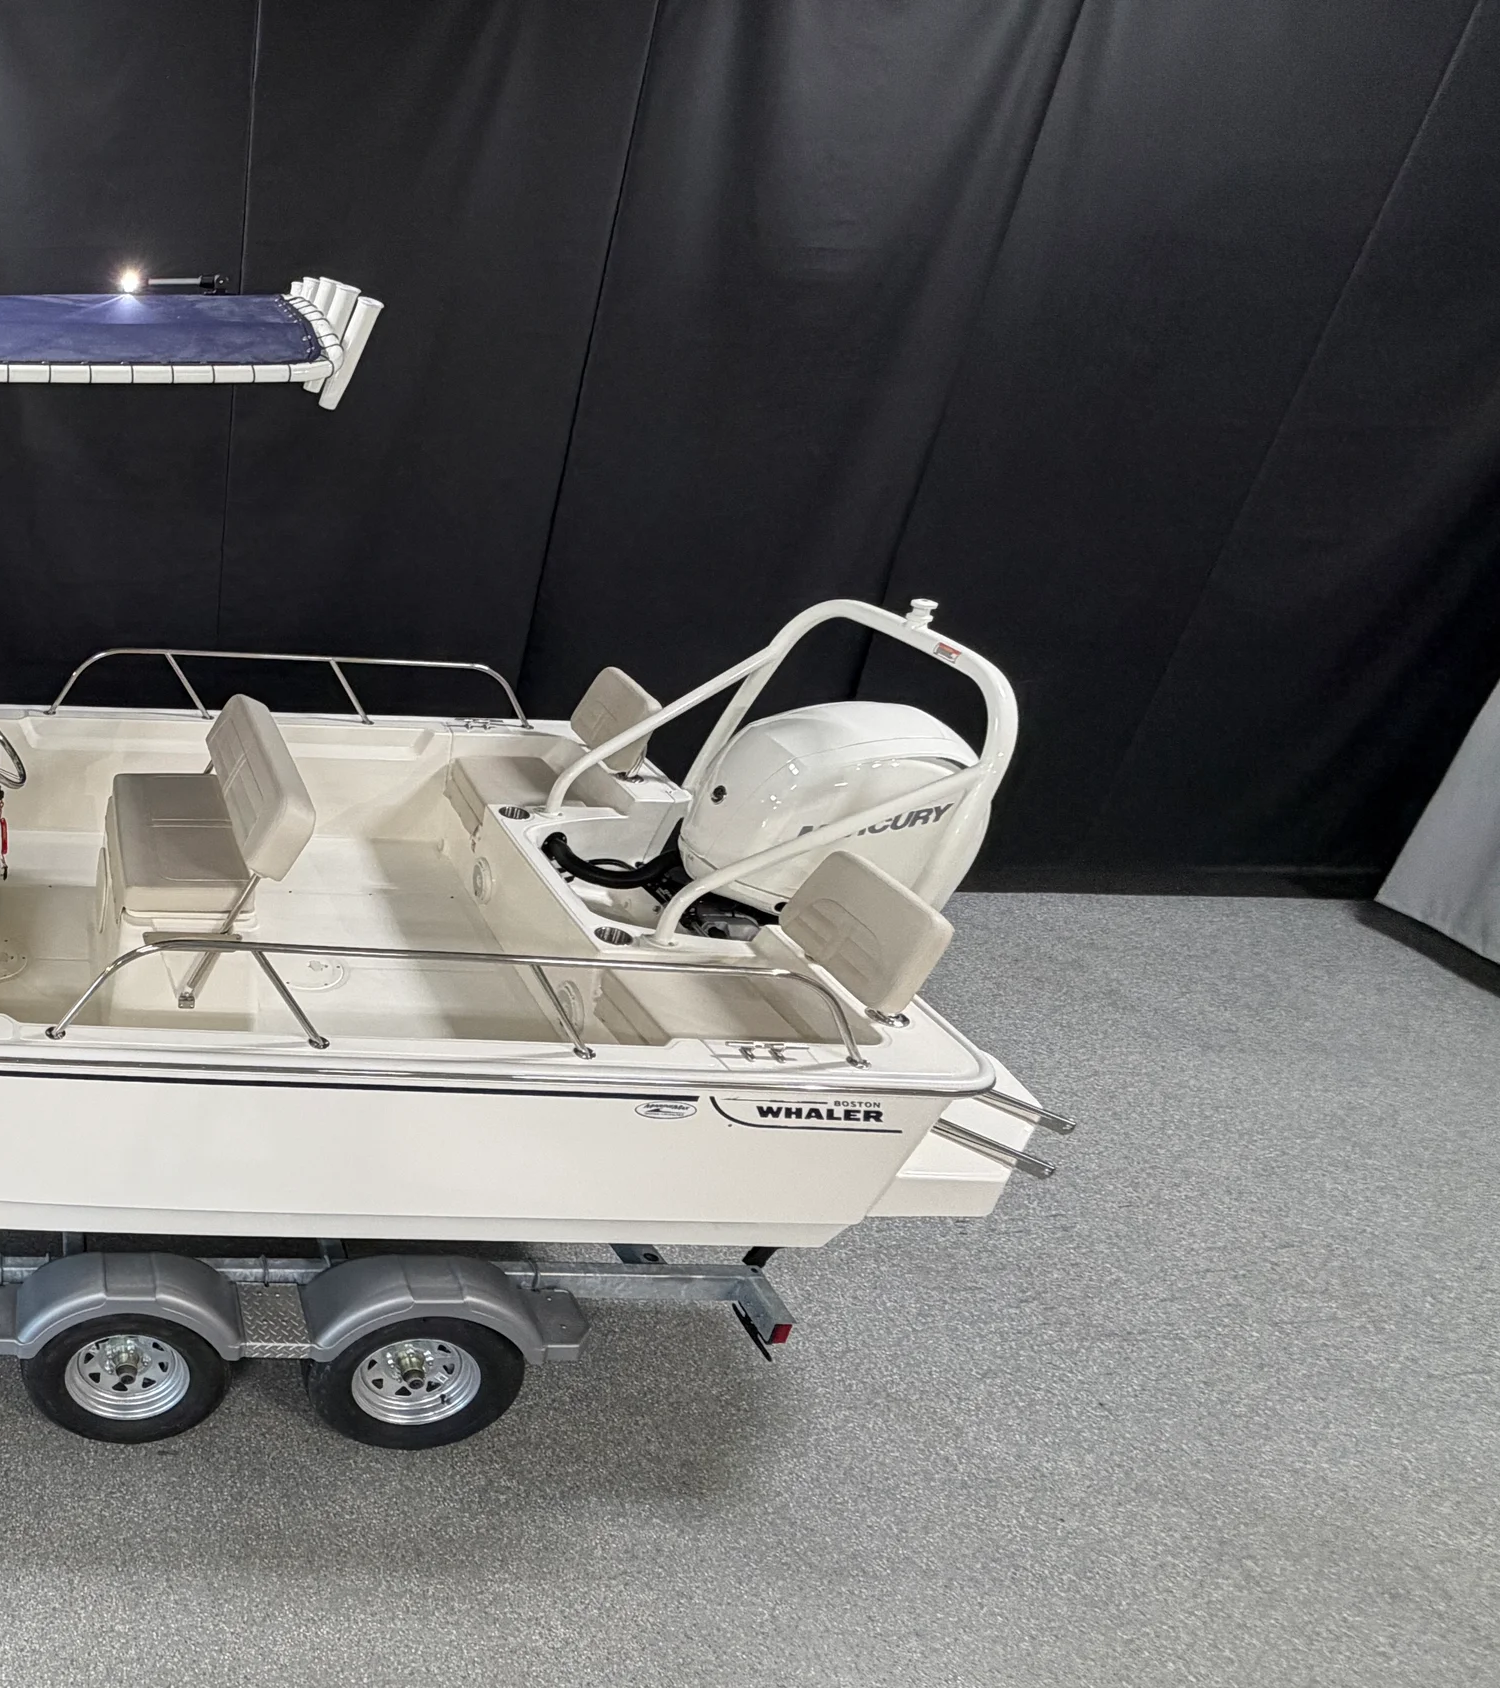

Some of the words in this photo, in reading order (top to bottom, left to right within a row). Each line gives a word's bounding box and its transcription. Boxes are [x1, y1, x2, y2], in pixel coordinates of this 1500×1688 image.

[797, 803, 954, 838] CURY
[834, 1100, 881, 1109] BOSTON
[756, 1106, 884, 1123] WHALER
